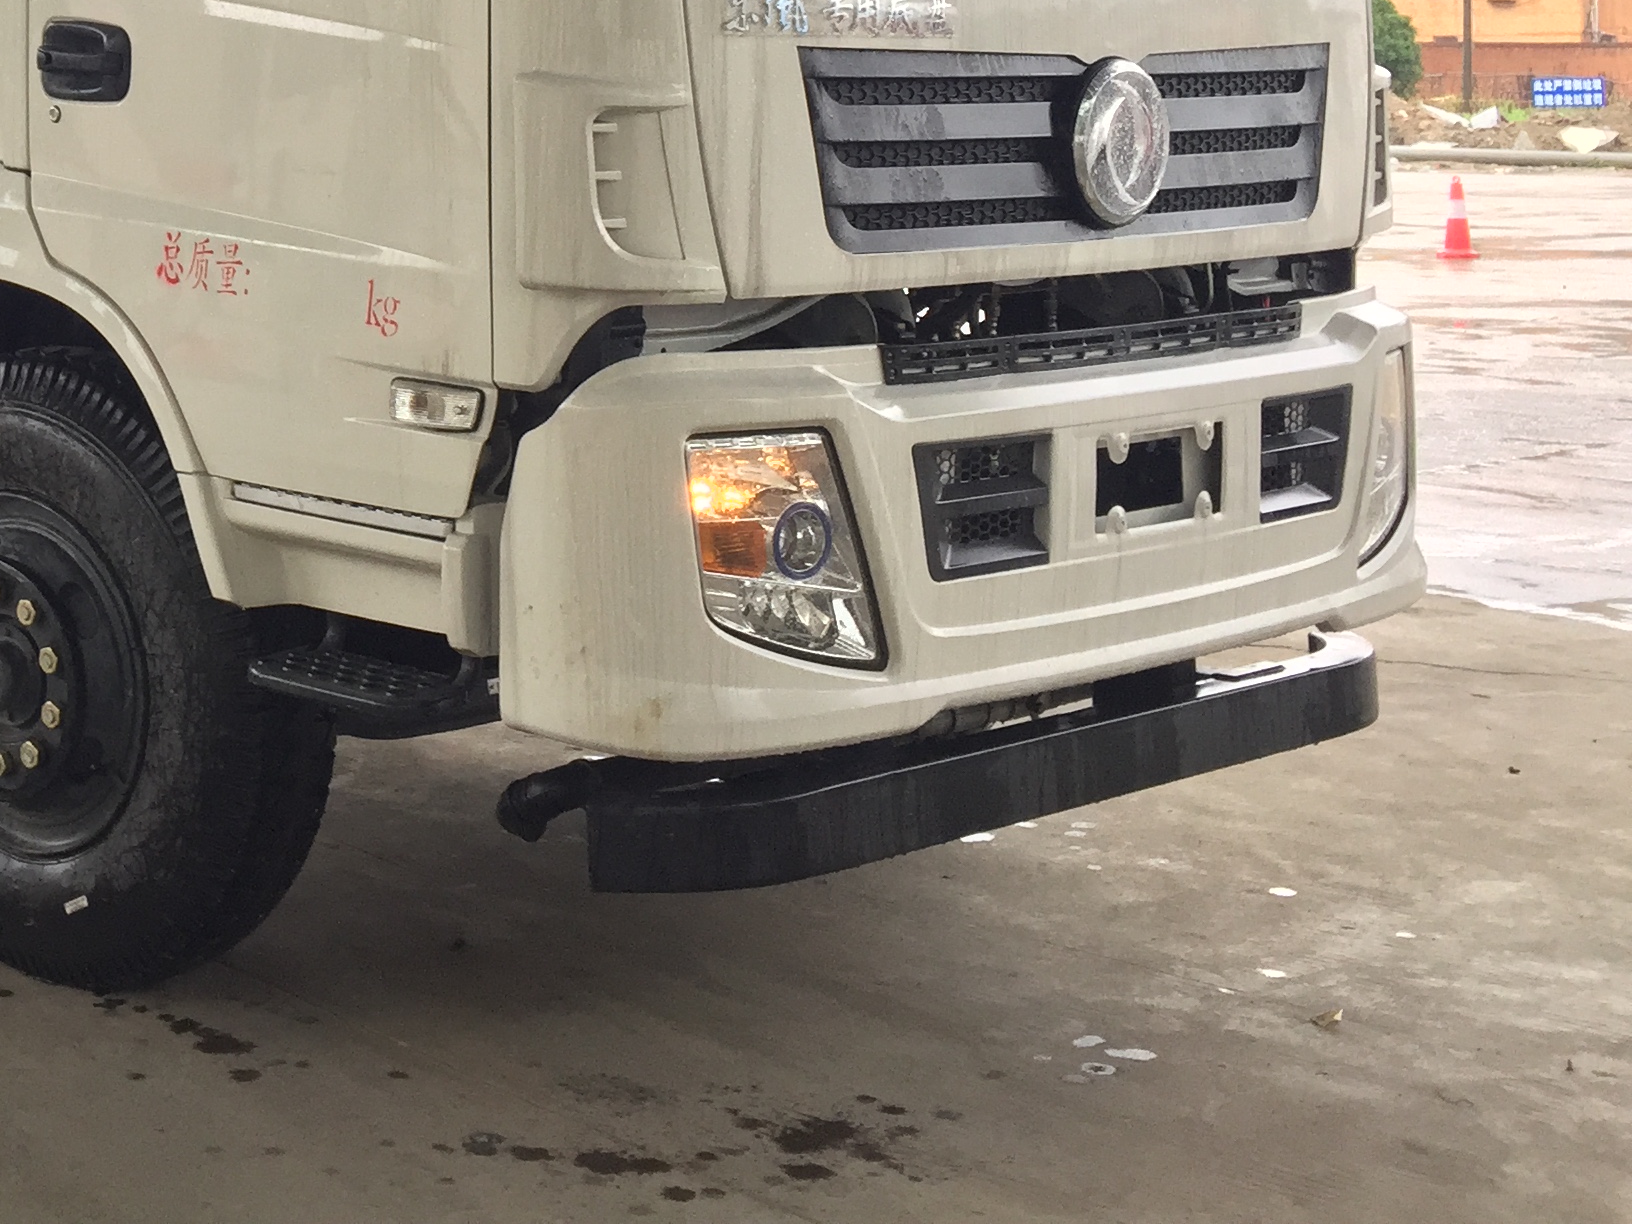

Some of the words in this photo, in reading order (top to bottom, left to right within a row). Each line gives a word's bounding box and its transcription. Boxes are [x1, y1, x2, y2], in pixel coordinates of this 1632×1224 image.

[156, 231, 252, 297] 总质量:
[365, 279, 401, 338] kg
